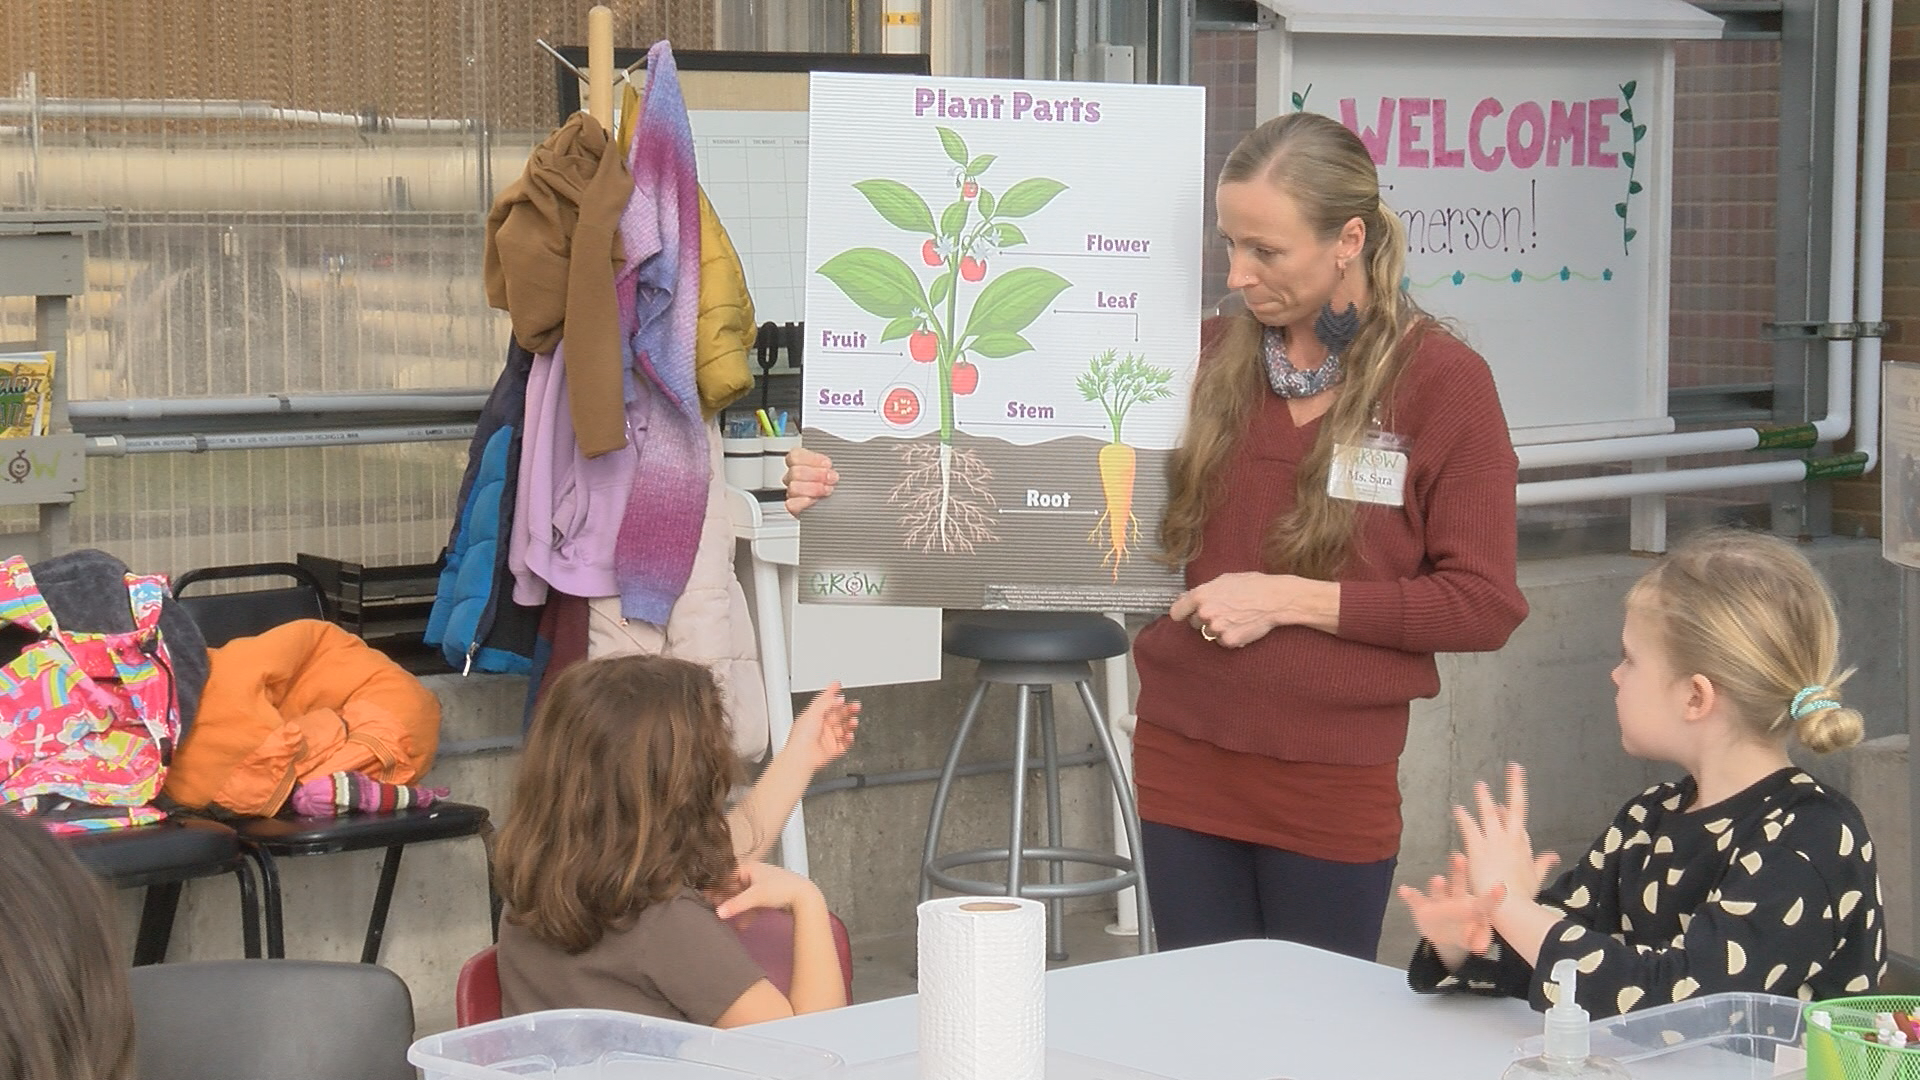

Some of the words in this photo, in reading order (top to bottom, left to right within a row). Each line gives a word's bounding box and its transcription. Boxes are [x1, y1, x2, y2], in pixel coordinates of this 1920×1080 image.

[915, 87, 1004, 119] Plant
[1013, 91, 1101, 123] Parts
[1339, 96, 1619, 172] WELCOME
[1379, 179, 1537, 253] merson!
[1087, 234, 1150, 253] Flower
[1097, 291, 1138, 309] Leaf
[822, 330, 867, 348] Fruit
[819, 388, 864, 406] Seed
[1007, 401, 1054, 419] Stem
[1347, 470, 1366, 482] Ms.
[1369, 473, 1392, 486] Sara
[1026, 489, 1071, 507] Root
[808, 571, 886, 596] GROW
